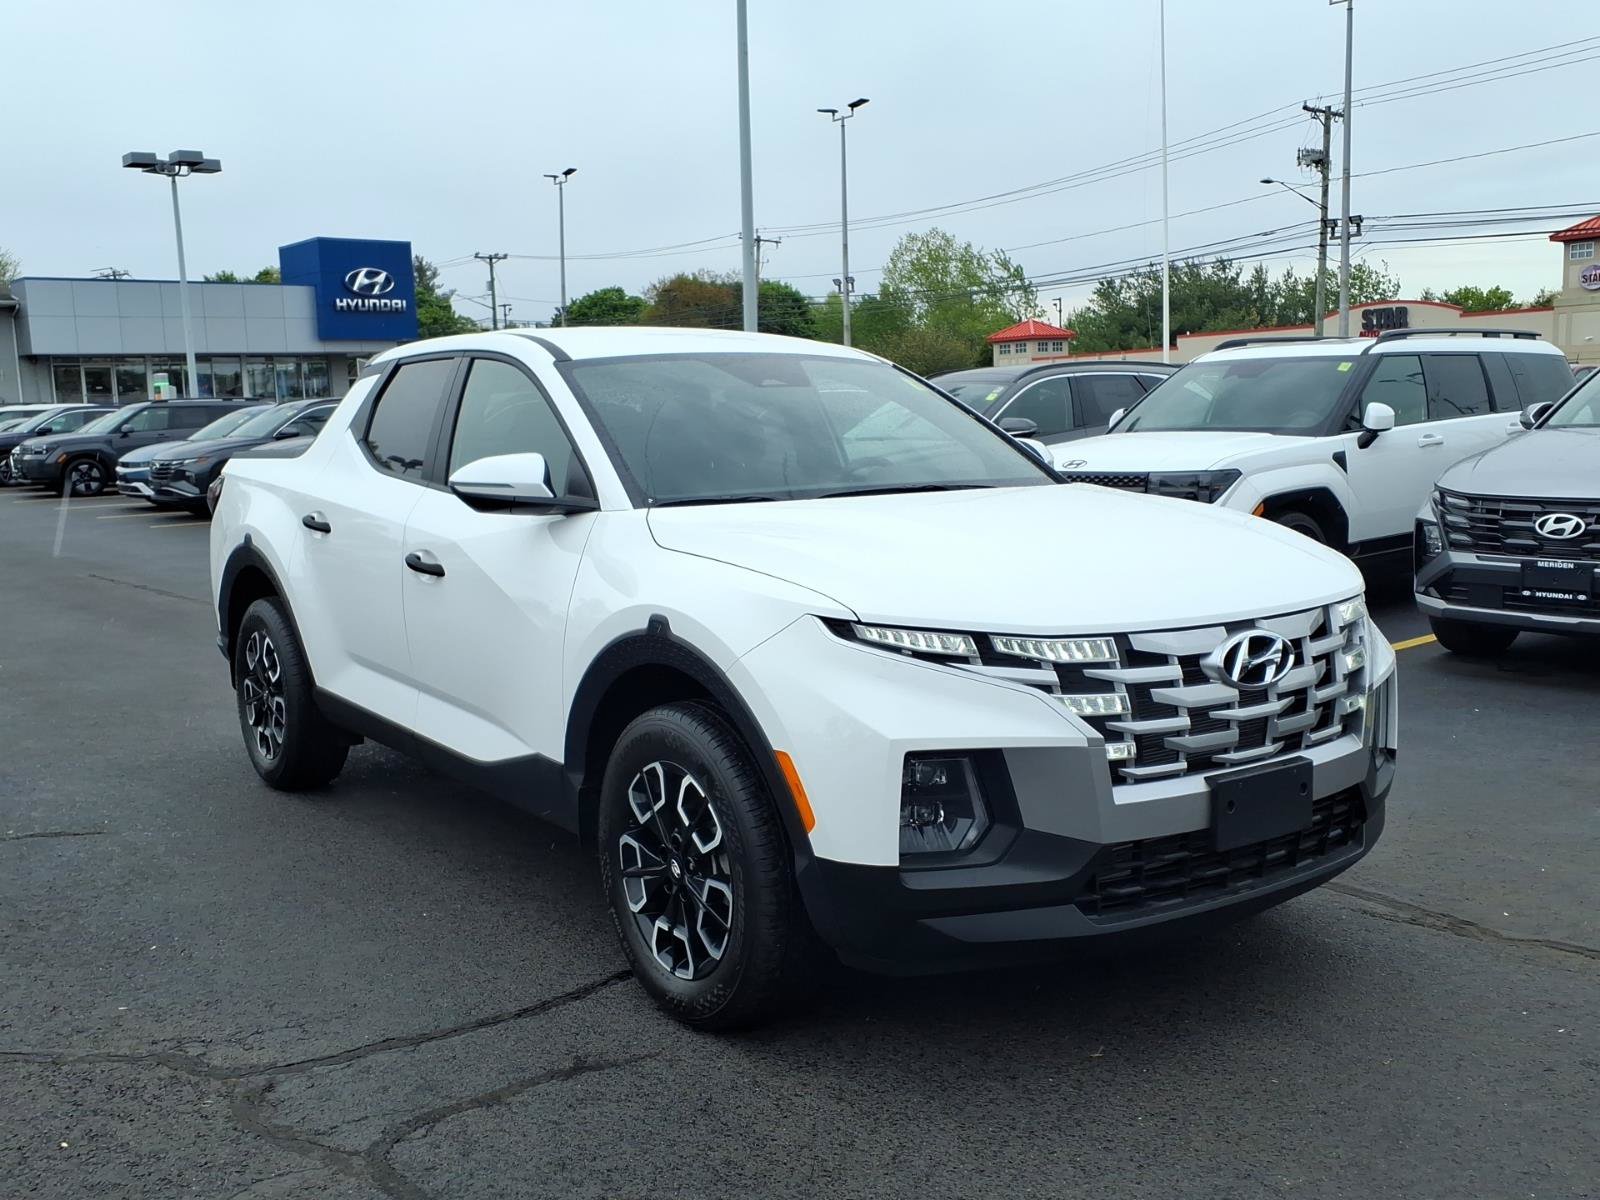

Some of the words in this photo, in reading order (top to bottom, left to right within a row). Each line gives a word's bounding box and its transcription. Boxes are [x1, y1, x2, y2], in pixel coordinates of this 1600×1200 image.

[1582, 272, 1600, 284] STA
[335, 297, 407, 311] HYUNDAI
[1361, 306, 1408, 330] STAR
[1537, 560, 1574, 569] MERIDEN
[1535, 591, 1573, 600] HYUNDAI
